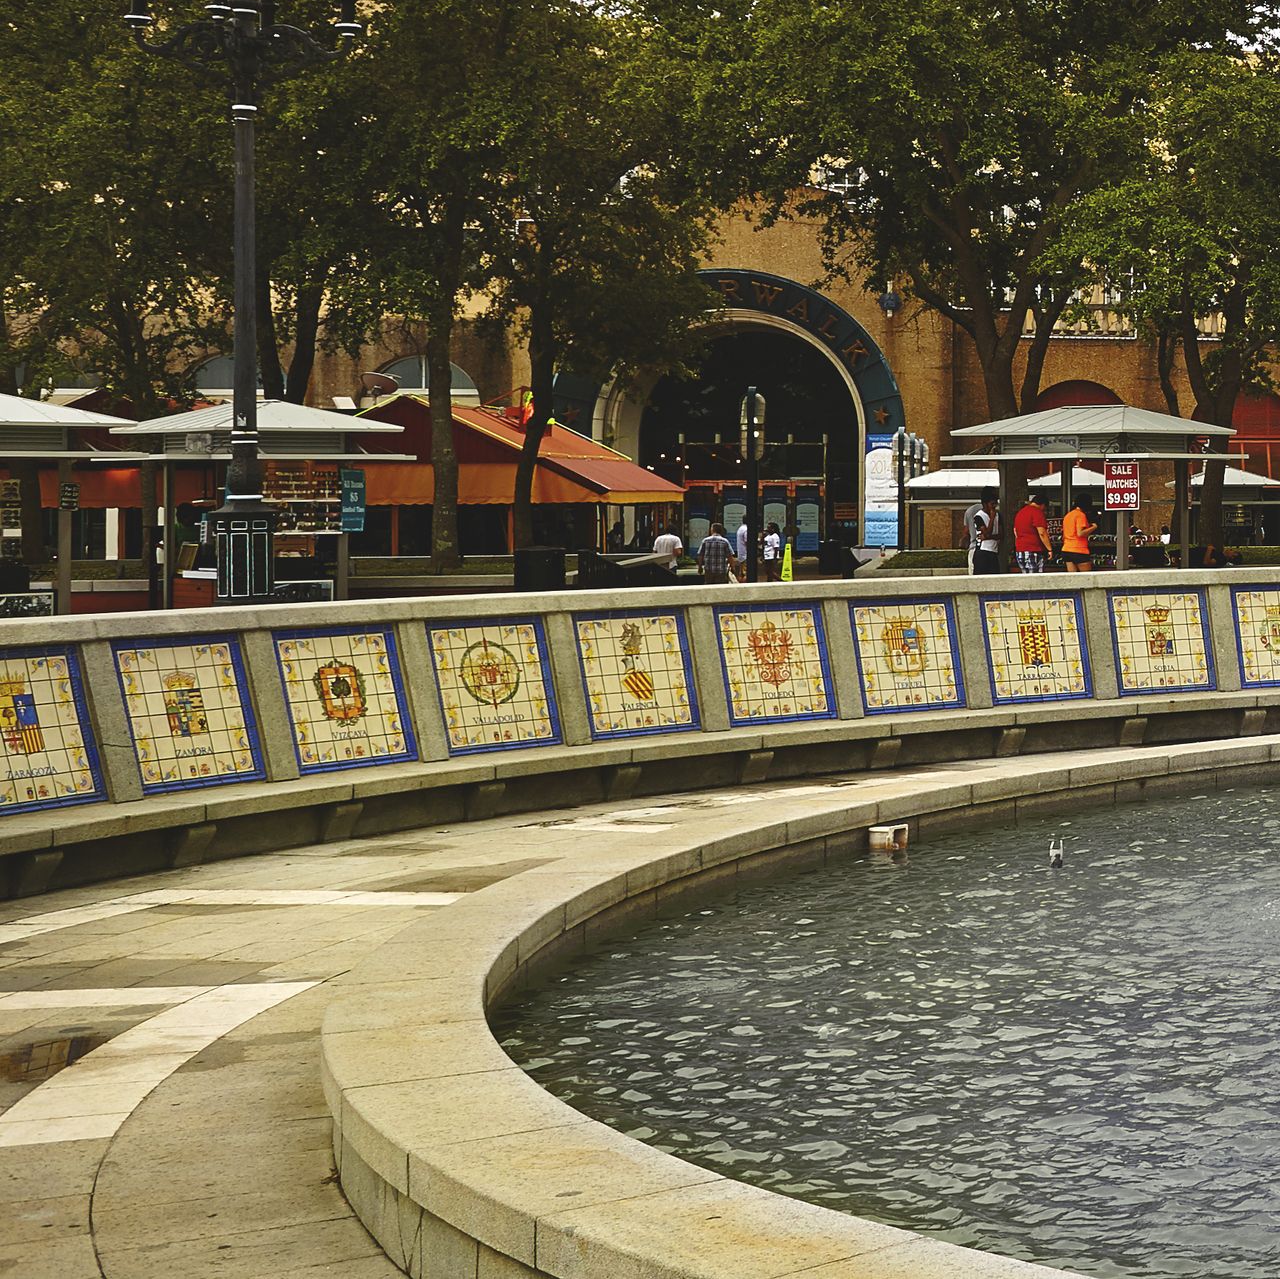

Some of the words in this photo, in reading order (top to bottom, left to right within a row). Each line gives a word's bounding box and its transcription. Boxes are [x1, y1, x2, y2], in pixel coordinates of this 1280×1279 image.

[718, 278, 870, 367] RWALK
[1111, 465, 1132, 475] SALE
[1106, 479, 1138, 489] WATCHES
[1107, 493, 1137, 505] $9.99
[1153, 664, 1176, 672] SORIA
[1016, 672, 1063, 681] TARRAGONA
[762, 690, 795, 700] TOLEDO
[620, 701, 660, 711] VALENCIA
[472, 713, 525, 726] VALLADOLID
[331, 730, 369, 740] VIZCAYA
[175, 745, 215, 759] ZAMORA
[5, 765, 58, 780] ZARAGOZA
